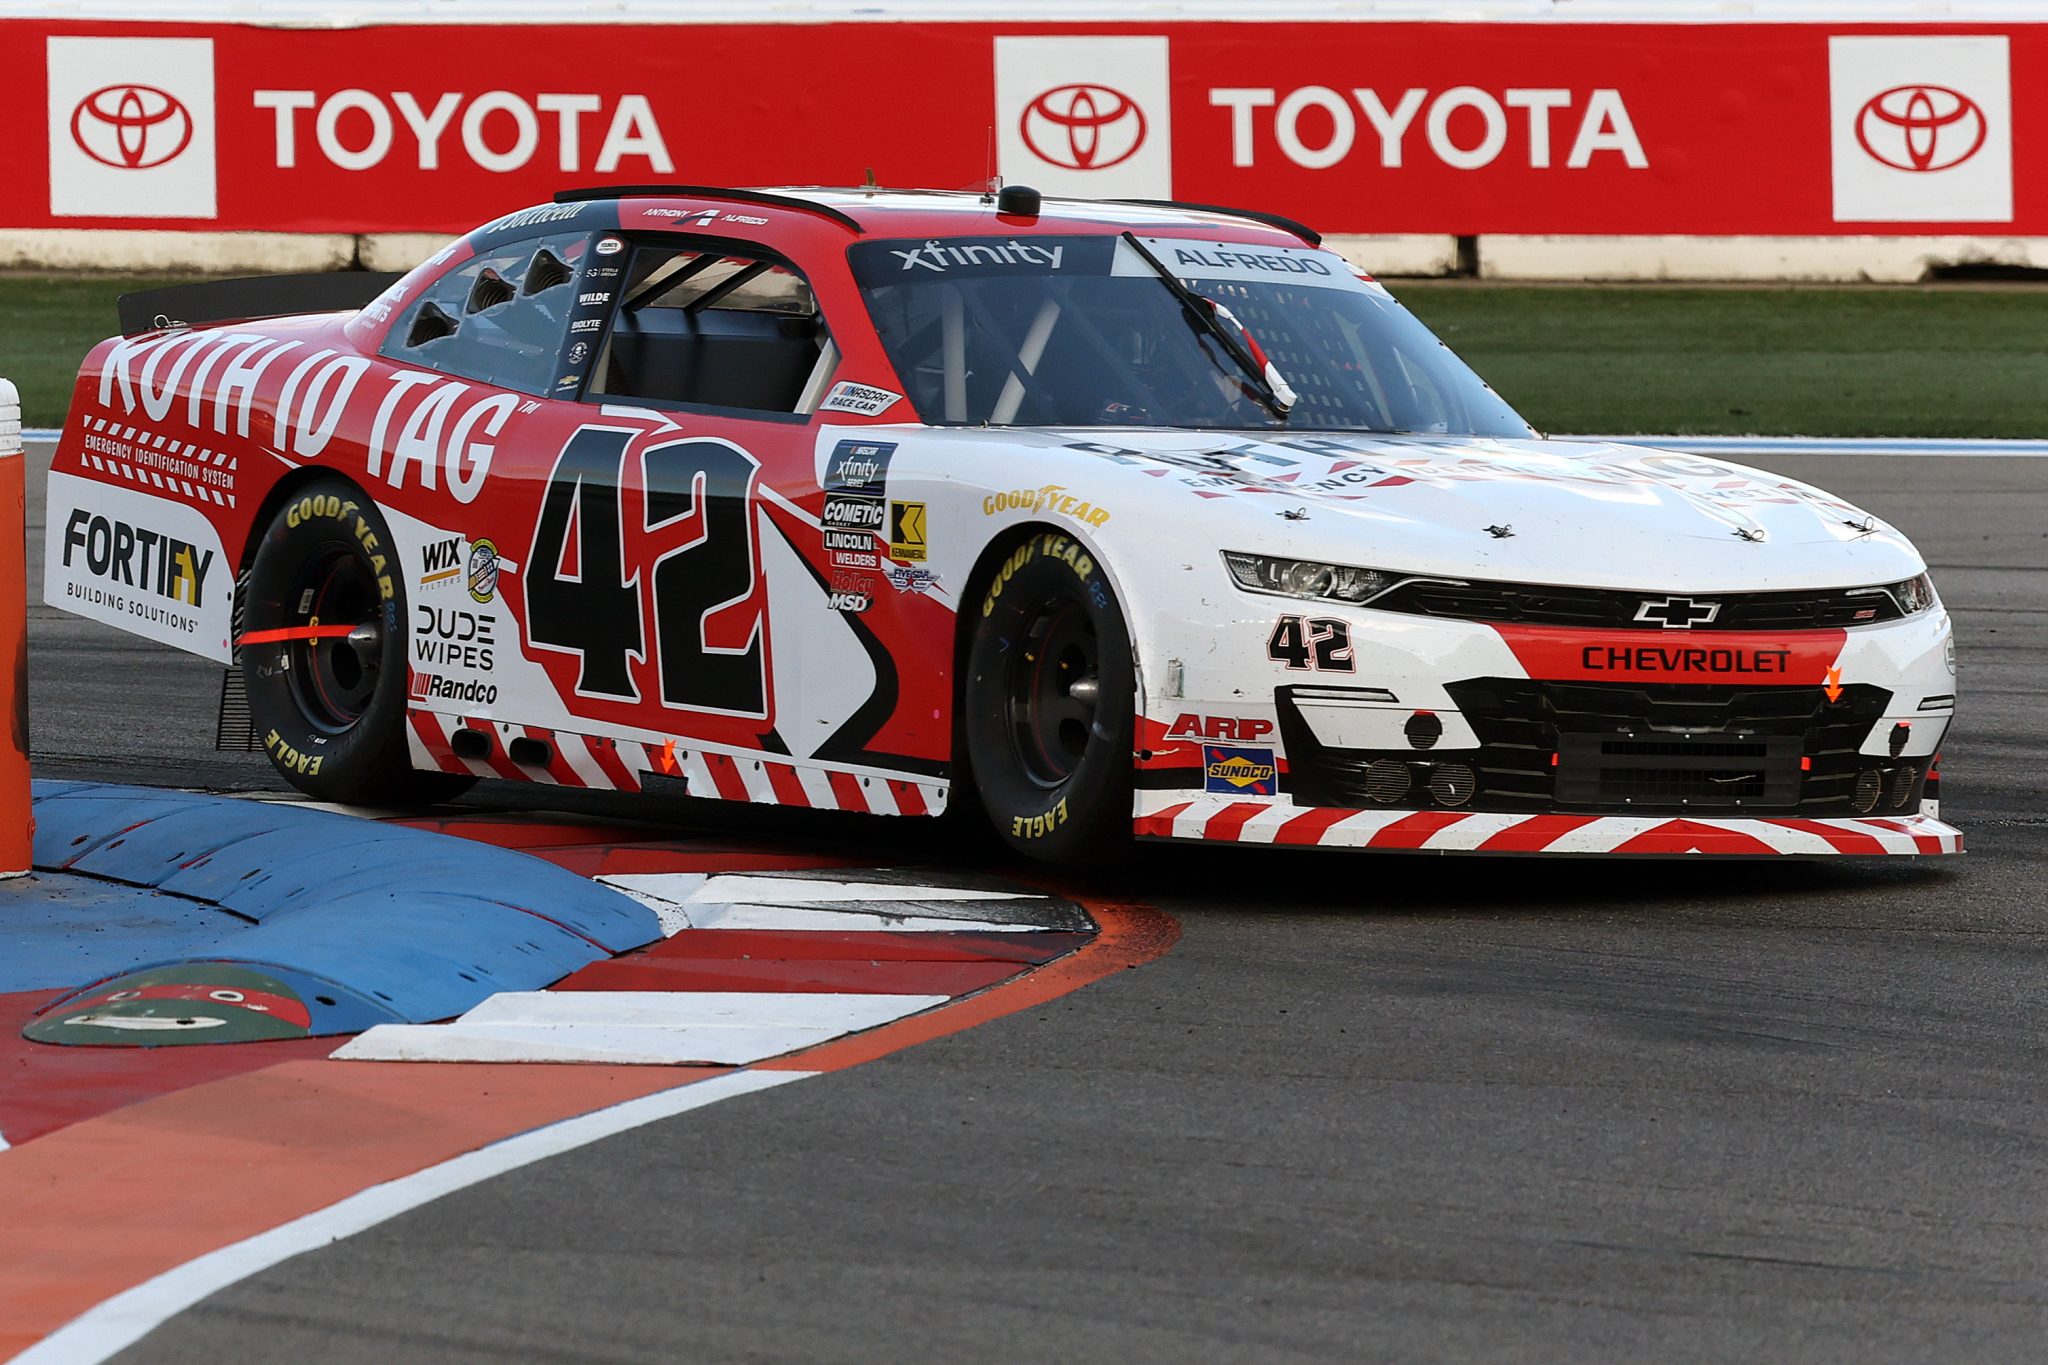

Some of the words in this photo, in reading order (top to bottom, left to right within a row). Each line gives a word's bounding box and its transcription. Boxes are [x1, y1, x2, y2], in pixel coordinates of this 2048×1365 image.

[254, 88, 675, 174] TOYOTA
[1209, 84, 1649, 170] TOYOTA
[643, 208, 691, 217] ANTHONY
[721, 214, 769, 225] ALFREDO
[890, 240, 1063, 272] xfinity
[1174, 249, 1331, 276] ALFREDO
[579, 292, 610, 303] WILDE
[829, 397, 854, 408] RACE
[855, 399, 877, 412] CAR
[848, 386, 889, 403] NASCAR
[367, 369, 521, 505] TAG
[85, 434, 132, 460] EMERGENCY
[135, 448, 200, 479] IDENTIFICATION
[202, 467, 234, 490] SYSTEM
[836, 456, 880, 483] xfinity
[846, 478, 865, 488] SERIES
[823, 502, 883, 525] COMETIC
[983, 485, 1110, 529] GOODYEAR
[287, 494, 394, 600] GOODYEAR
[423, 536, 461, 573] WIX
[826, 532, 872, 551] LINCOLN
[63, 508, 214, 608] FORTIFY
[523, 423, 770, 721] 42
[836, 551, 877, 567] WELDERS
[420, 575, 461, 592] FILTERS
[830, 570, 875, 600] Holley
[983, 533, 1093, 618] GOODYEAR
[67, 582, 124, 610] BUILDING
[129, 601, 194, 633] SOLUTIONS
[828, 593, 867, 611] MSD
[416, 604, 496, 645] DUDE
[416, 638, 494, 671] WIPES
[1267, 613, 1356, 674] 42
[1582, 646, 1791, 673] CHEVROLET
[429, 674, 497, 704] Randco
[1167, 713, 1274, 741] ARP
[265, 728, 324, 776] EAGLE
[1210, 764, 1271, 780] SUNOCO
[1012, 796, 1069, 839] EAGLE
